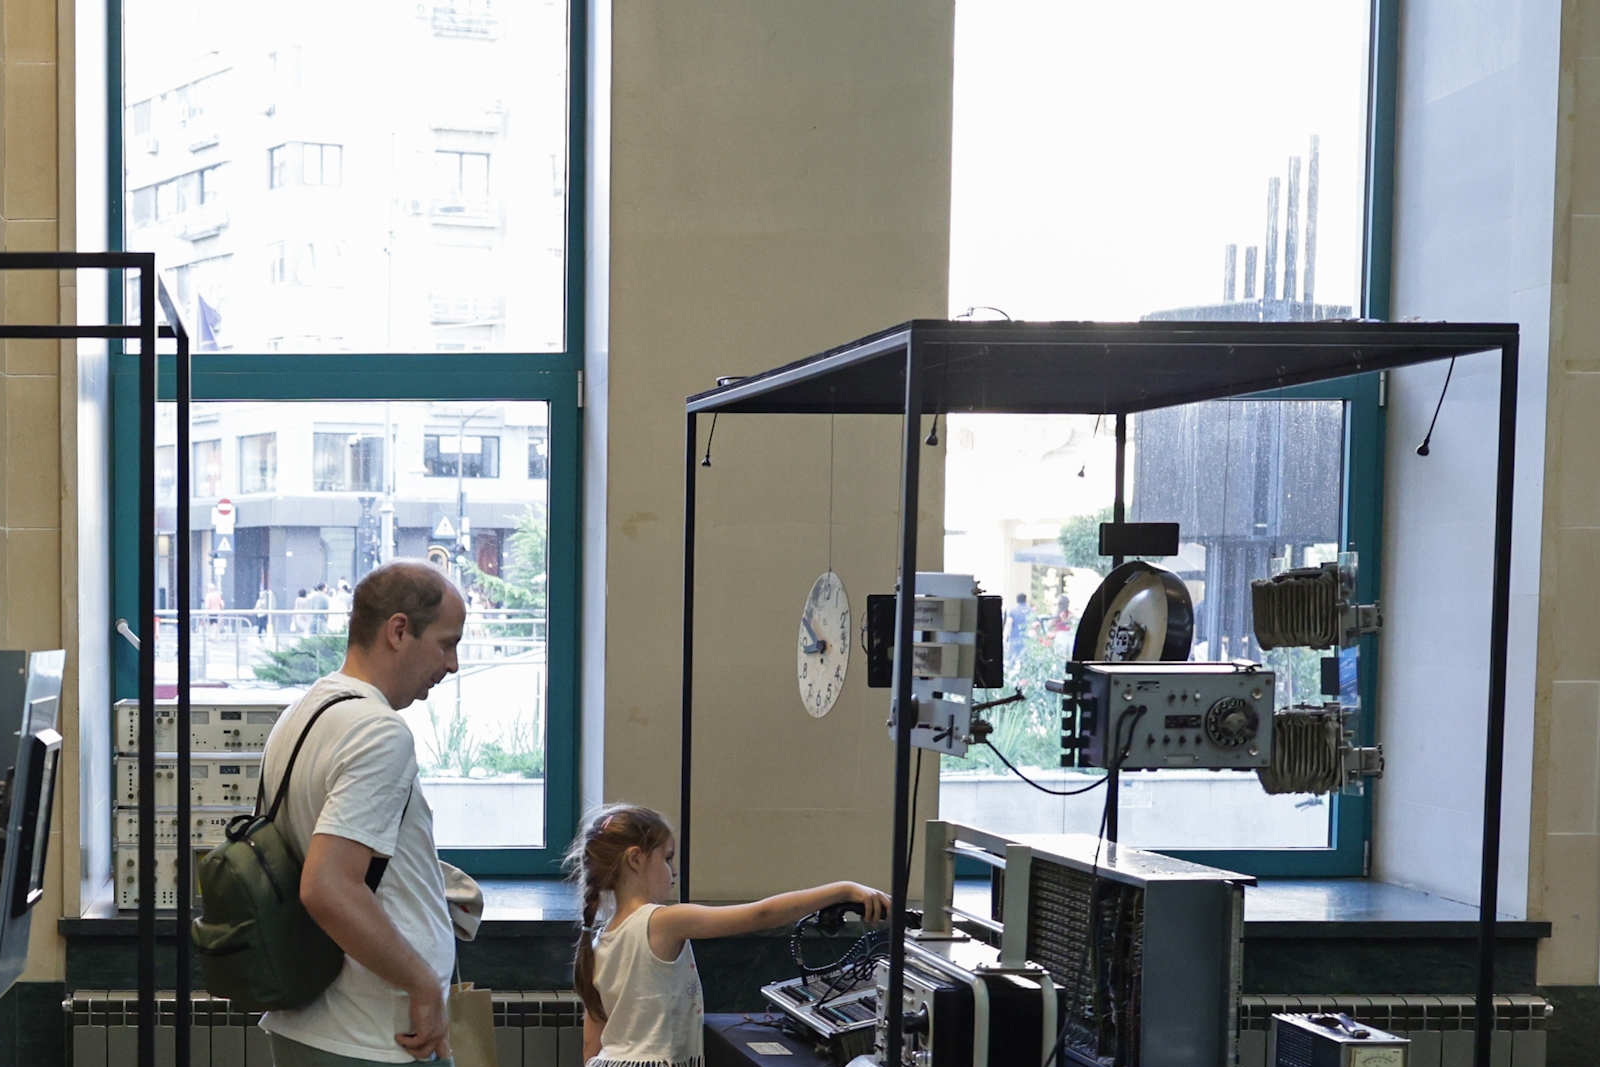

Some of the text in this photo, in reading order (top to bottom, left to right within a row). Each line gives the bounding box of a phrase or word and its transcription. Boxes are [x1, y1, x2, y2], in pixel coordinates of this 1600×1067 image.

[840, 611, 846, 629] 2
[802, 662, 808, 679] 8
[816, 690, 821, 707] 6
[826, 683, 832, 701] 5
